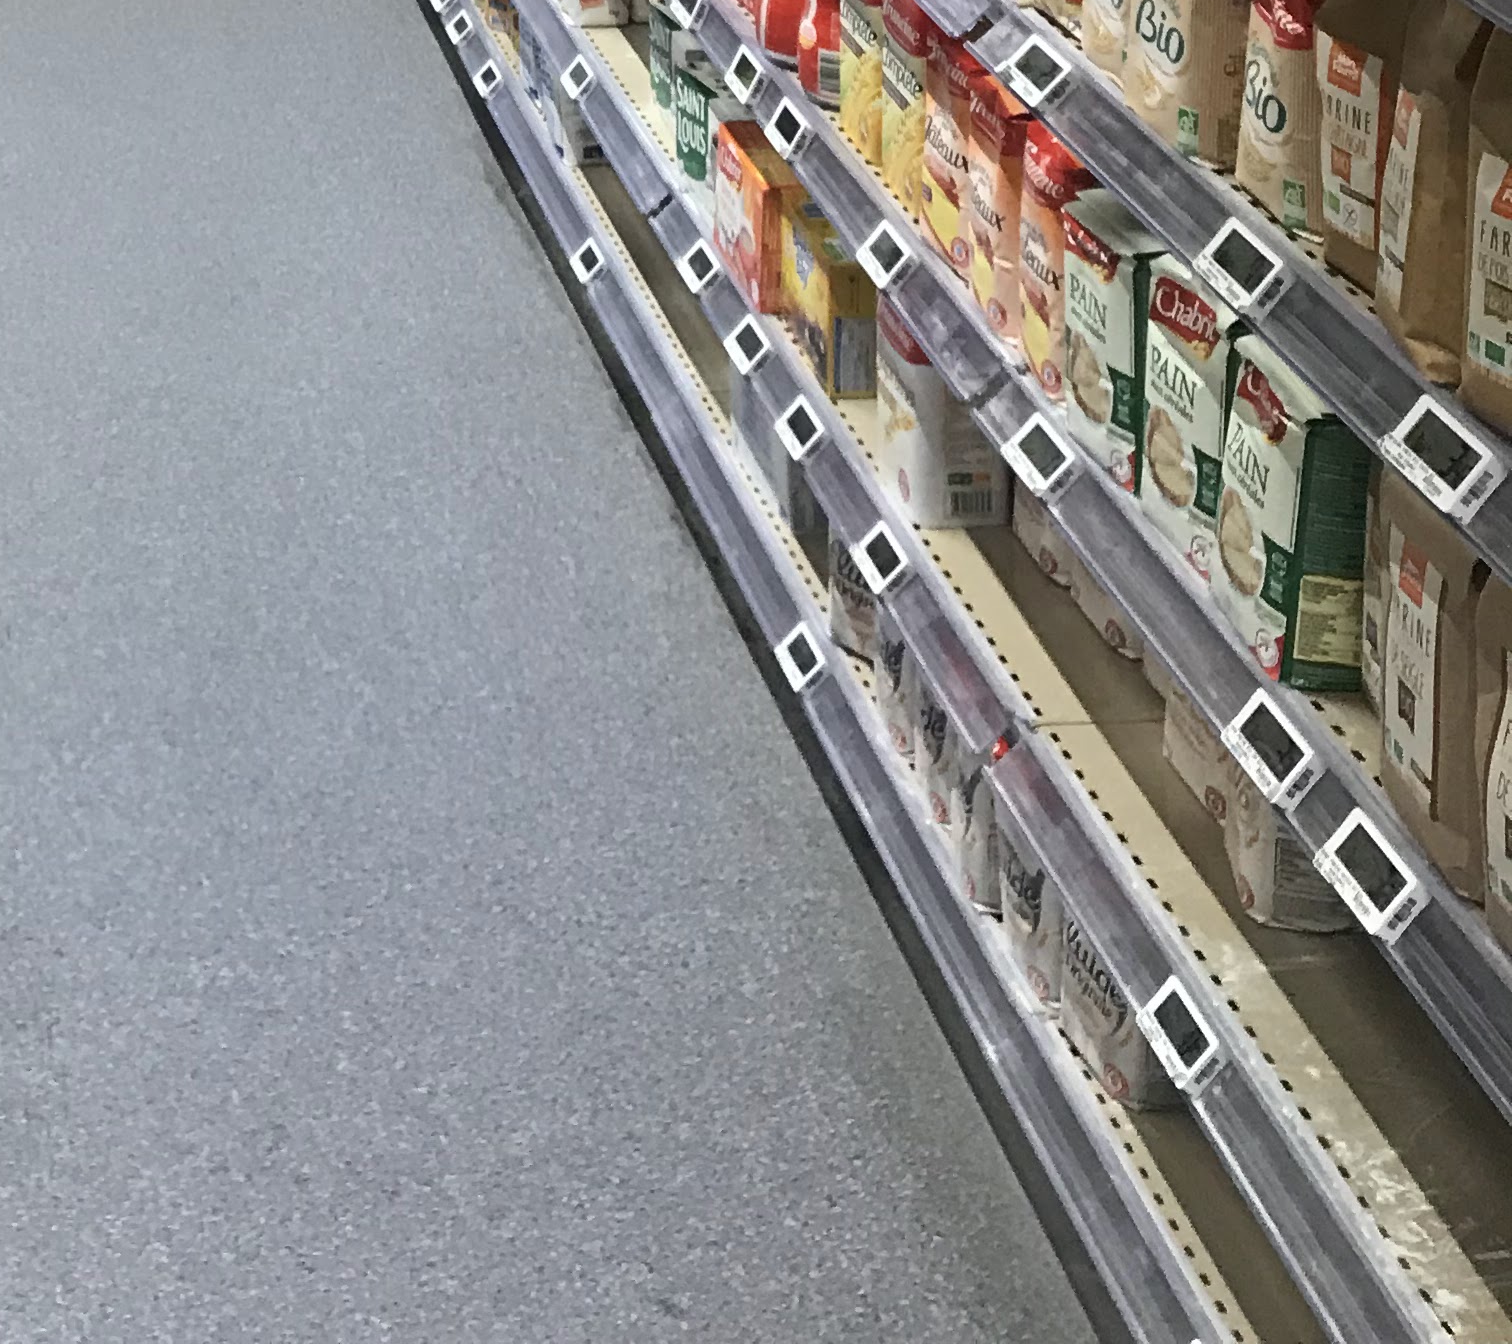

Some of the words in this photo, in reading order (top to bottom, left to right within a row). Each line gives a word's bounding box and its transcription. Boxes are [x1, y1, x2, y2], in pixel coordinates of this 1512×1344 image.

[677, 79, 706, 117] SAINT
[1245, 58, 1287, 135] Bio
[677, 114, 707, 156] LOUIS
[1069, 270, 1108, 332] PAIN
[1149, 342, 1198, 411] PAIN
[1228, 421, 1270, 497] PAIN
